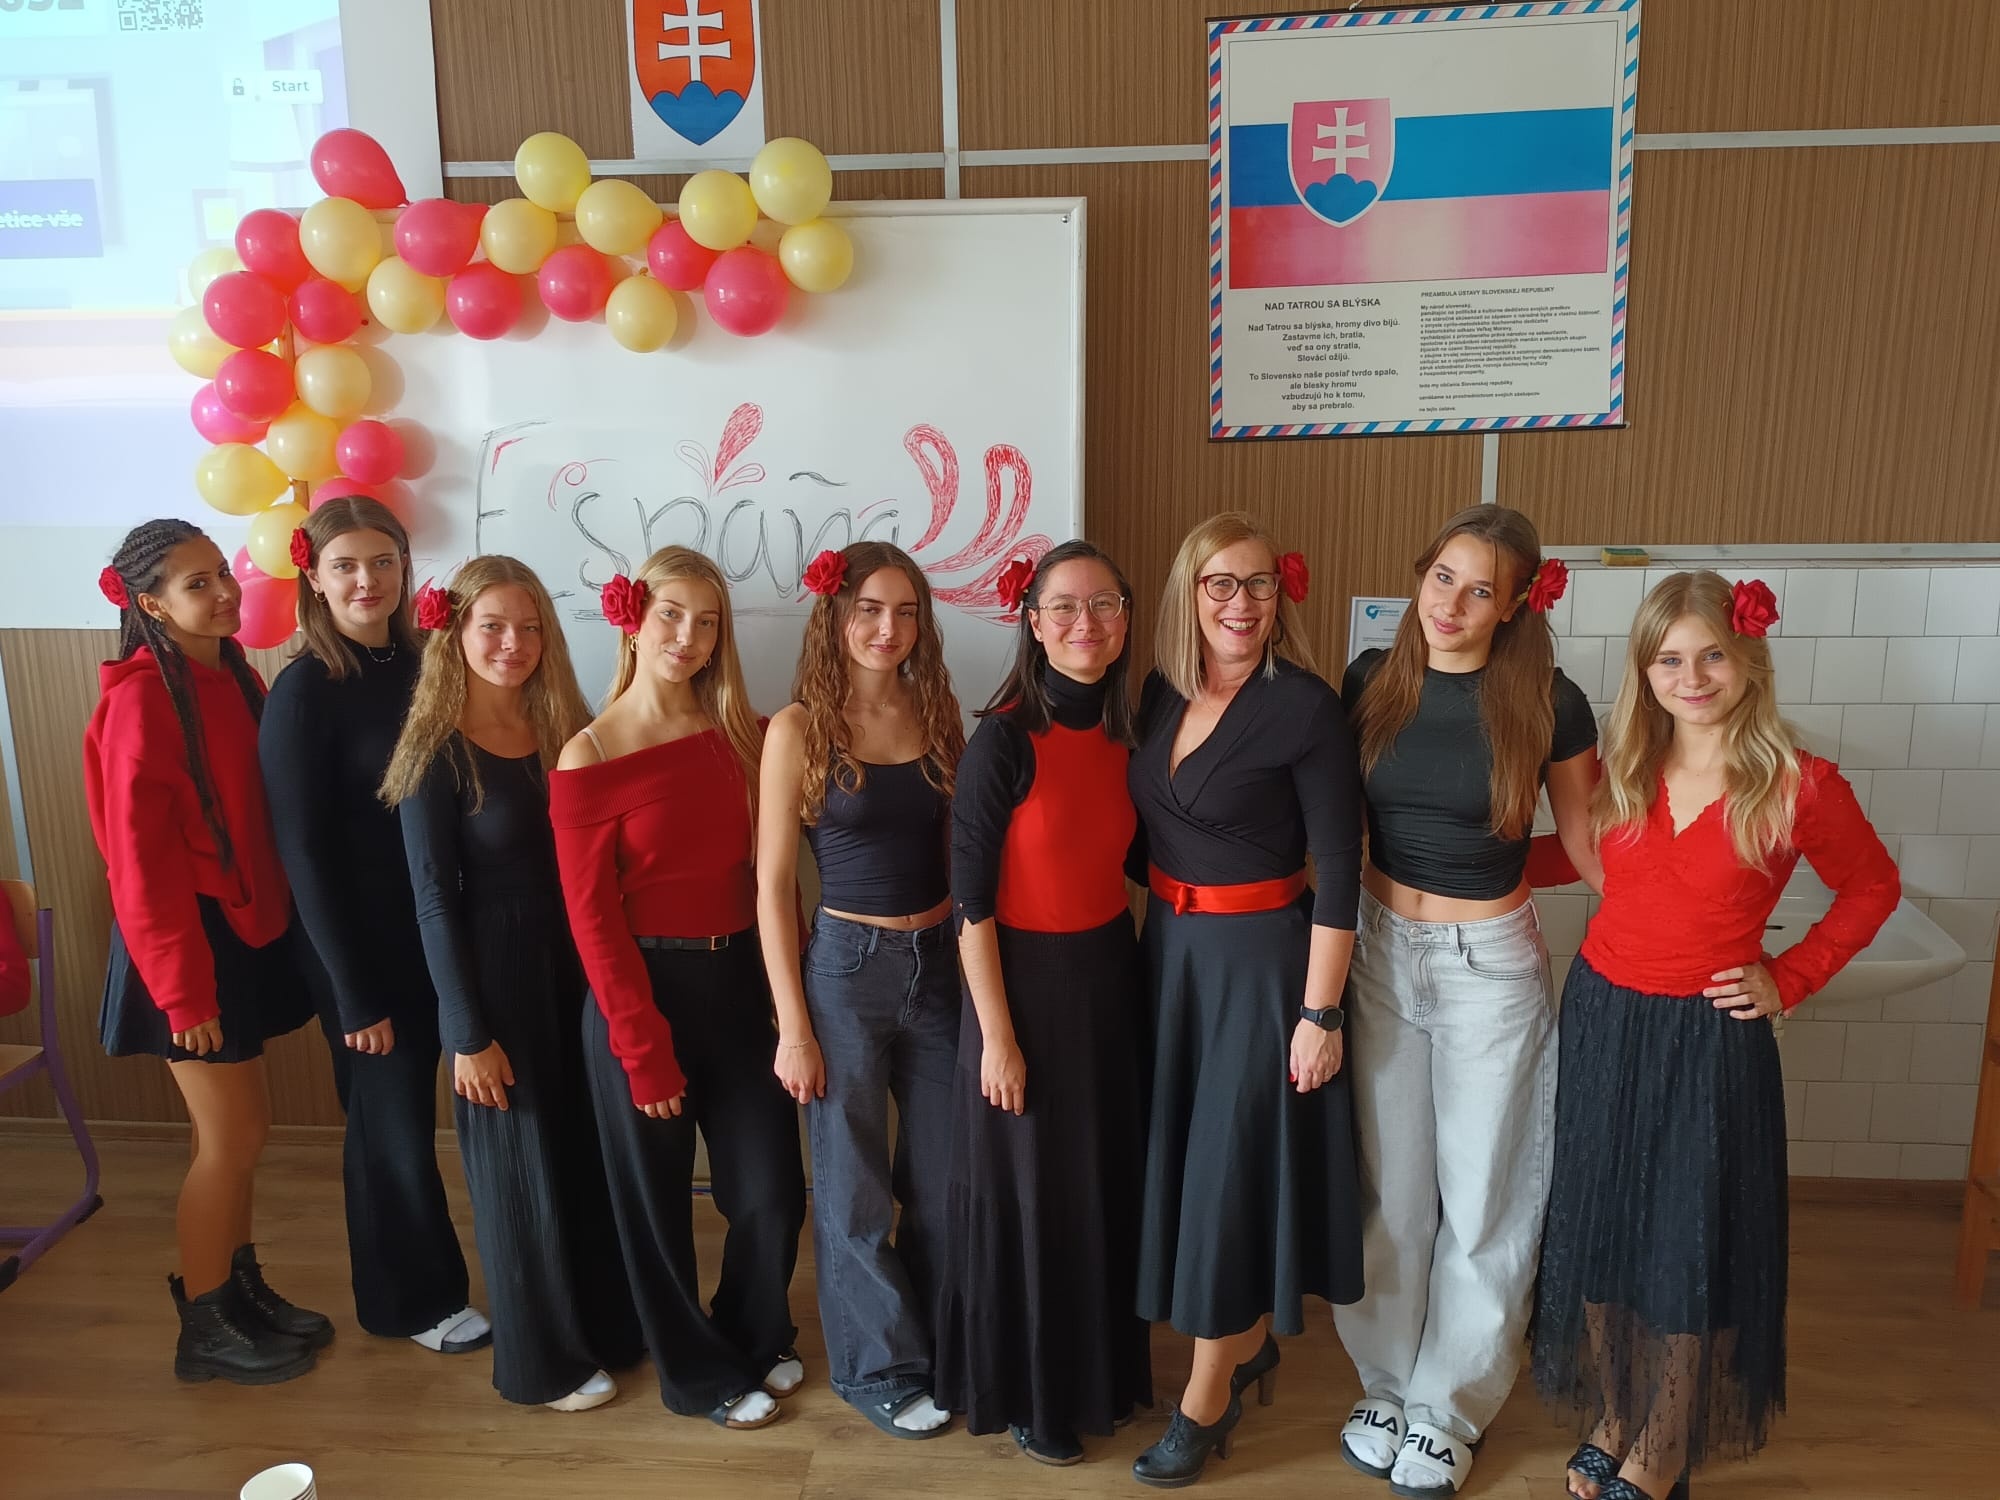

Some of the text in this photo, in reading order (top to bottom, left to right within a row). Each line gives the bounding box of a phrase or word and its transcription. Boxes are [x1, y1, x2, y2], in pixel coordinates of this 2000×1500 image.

[272, 80, 310, 92] Start
[1265, 298, 1380, 311] NAD TATROU SA BLÝSKA
[1336, 321, 1361, 329] hromy
[1261, 372, 1301, 380] Slovensko
[1374, 368, 1398, 376] spalo,
[1303, 382, 1329, 390] blesky
[1281, 392, 1321, 400] vzbudzujú
[1320, 402, 1354, 410] prebralo.
[1349, 1409, 1398, 1435] FILA
[1404, 1433, 1456, 1467] FILA
